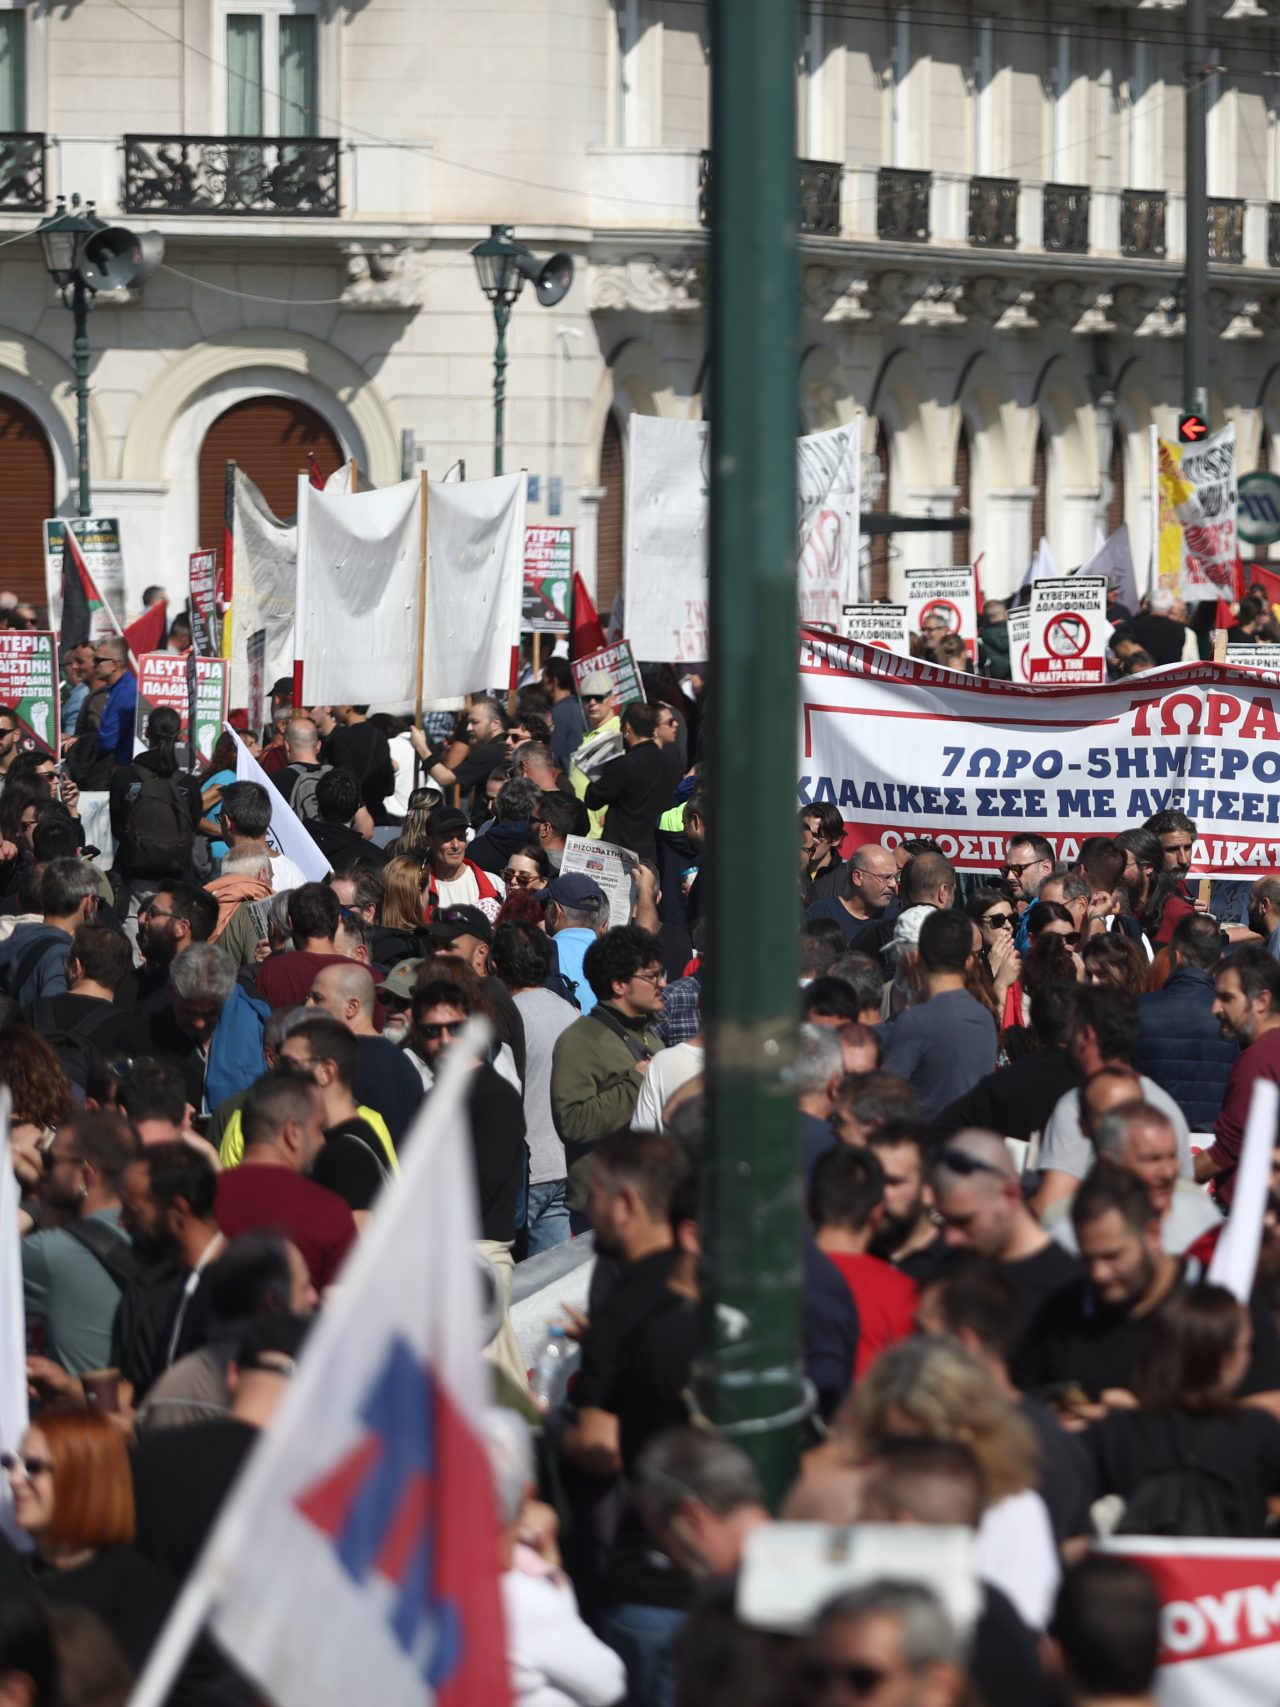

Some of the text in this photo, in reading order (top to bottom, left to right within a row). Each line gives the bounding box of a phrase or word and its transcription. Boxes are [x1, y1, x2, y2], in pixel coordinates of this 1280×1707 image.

[1039, 590, 1098, 601] ΚΥΒΕΡΝΗΣΗ
[799, 638, 864, 673] ΕΡΜΑ
[870, 649, 915, 679] ΠΙΑ
[144, 659, 222, 678] ΛΕΥΤΡΙΑ
[143, 681, 221, 698] ΠΑΛΑΙΣΙΝΗ
[1128, 693, 1280, 741] ΤΩΡΑ
[975, 788, 1048, 818] ΣΣΕ
[1057, 789, 1117, 818] ΜΕ
[573, 843, 623, 858] ΡΙΖΟΣΠΑΣΤΗΣ
